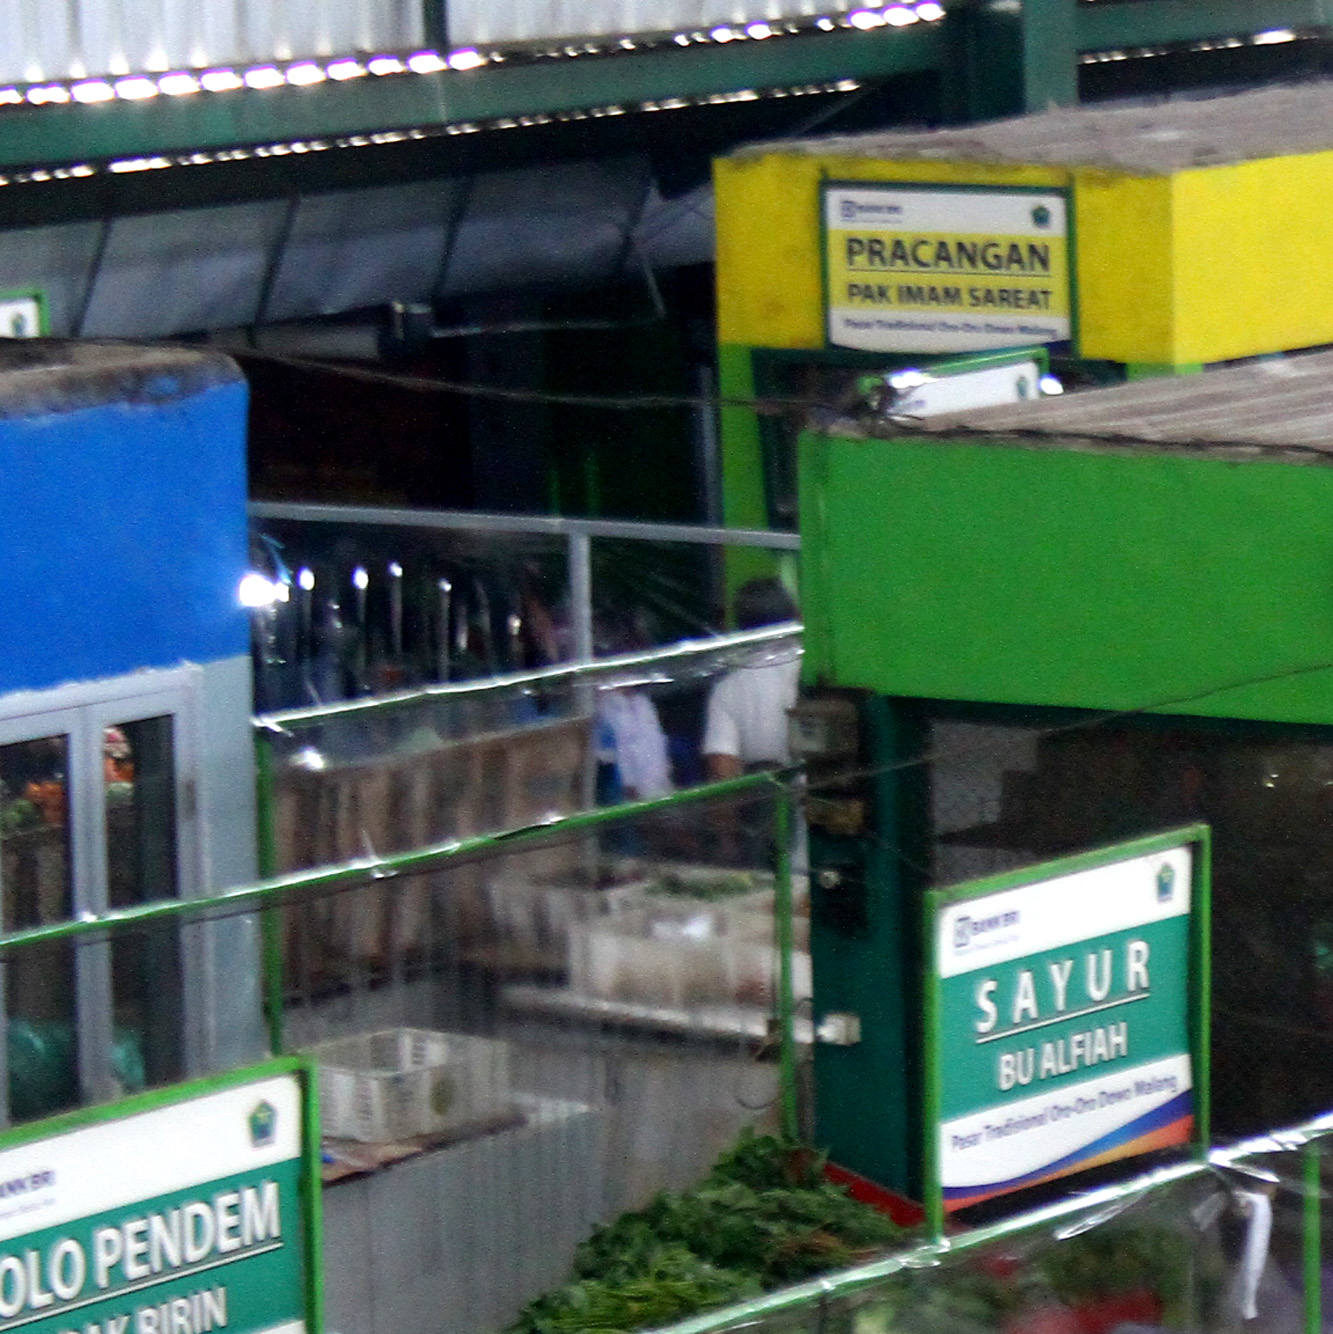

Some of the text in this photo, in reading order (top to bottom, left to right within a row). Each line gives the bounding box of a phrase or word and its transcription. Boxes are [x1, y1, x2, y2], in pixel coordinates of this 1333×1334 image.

[846, 238, 1050, 271] PRACANGAN
[848, 284, 1052, 310] PAK IMAM SAREAT
[975, 939, 1150, 1033] SAYUR
[998, 1021, 1128, 1091] BU ALFIAH
[31, 1169, 56, 1190] BRI
[0, 1181, 281, 1319] OLO PENDEM
